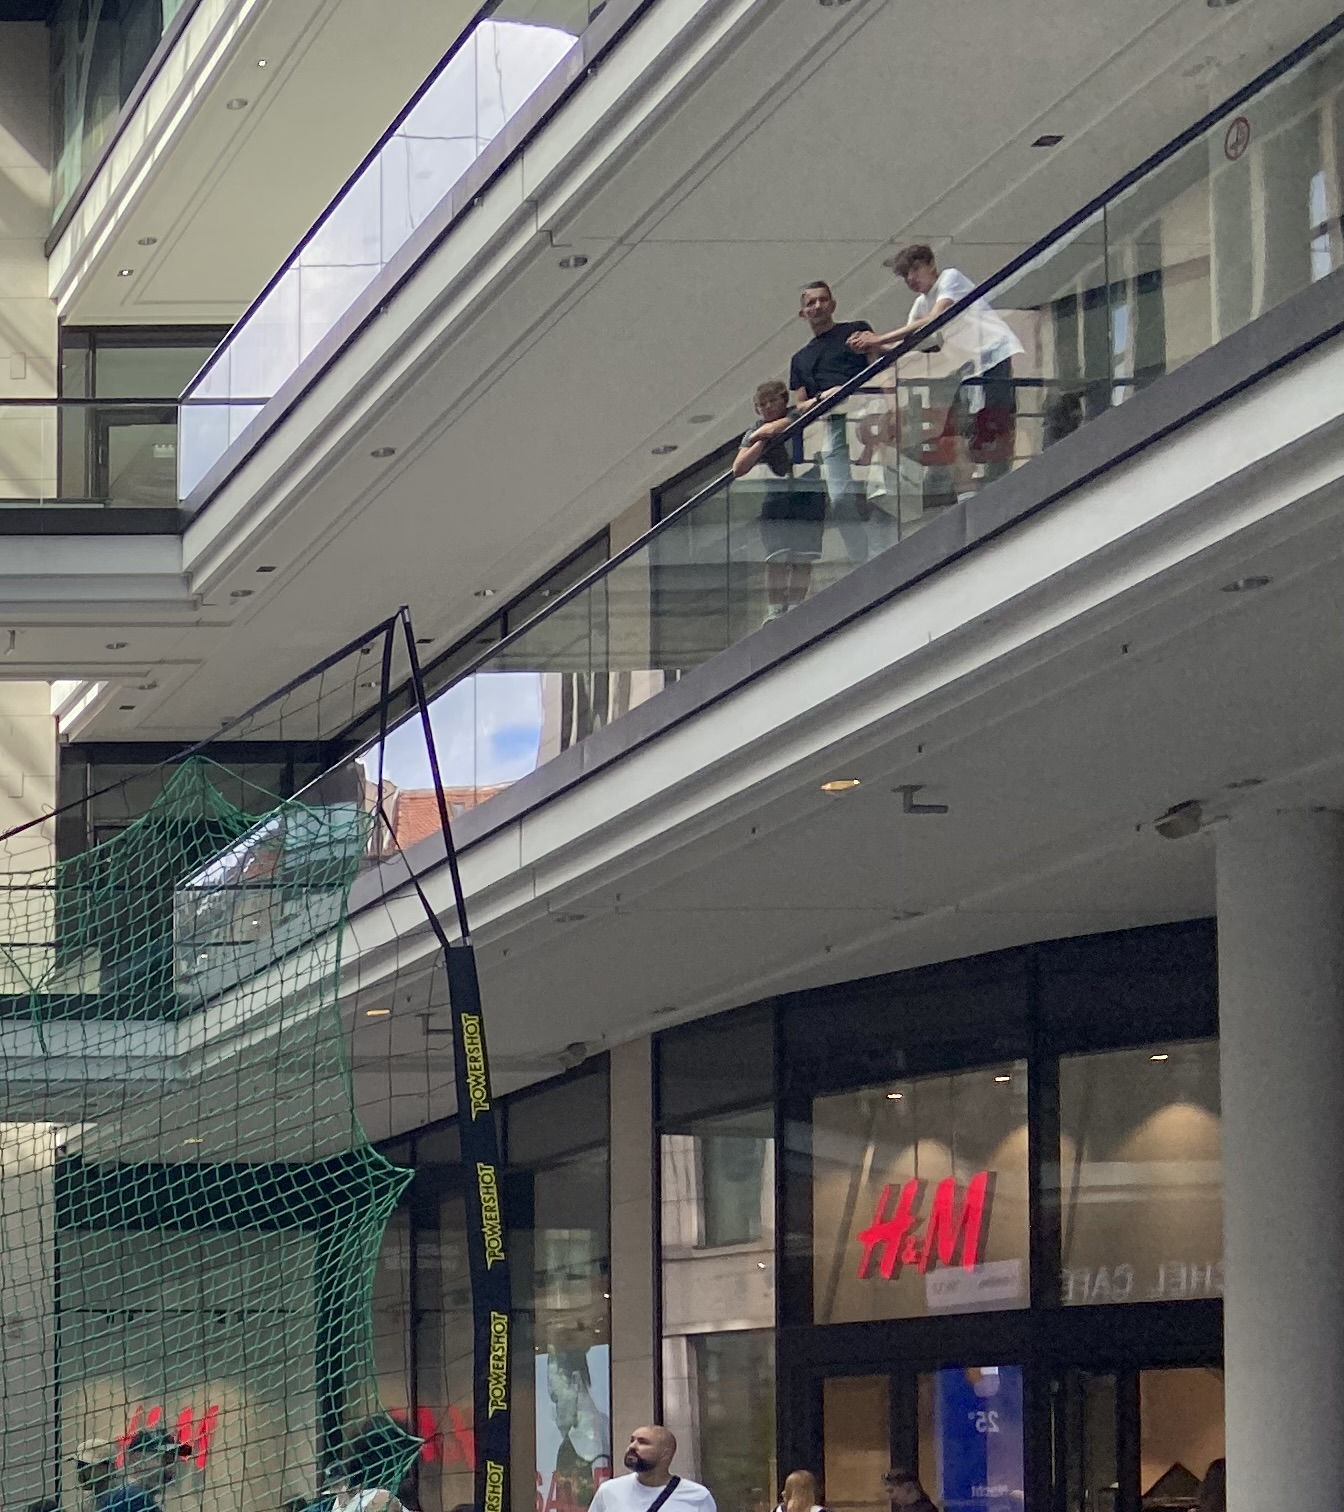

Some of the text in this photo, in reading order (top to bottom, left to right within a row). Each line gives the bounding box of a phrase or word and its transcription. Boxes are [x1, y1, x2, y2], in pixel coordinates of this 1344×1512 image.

[461, 1013, 490, 1122] POWERSHOT
[477, 1162, 506, 1271] POWERSHOT
[856, 1170, 993, 1281] H&M
[488, 1311, 509, 1420] POWERSHOT
